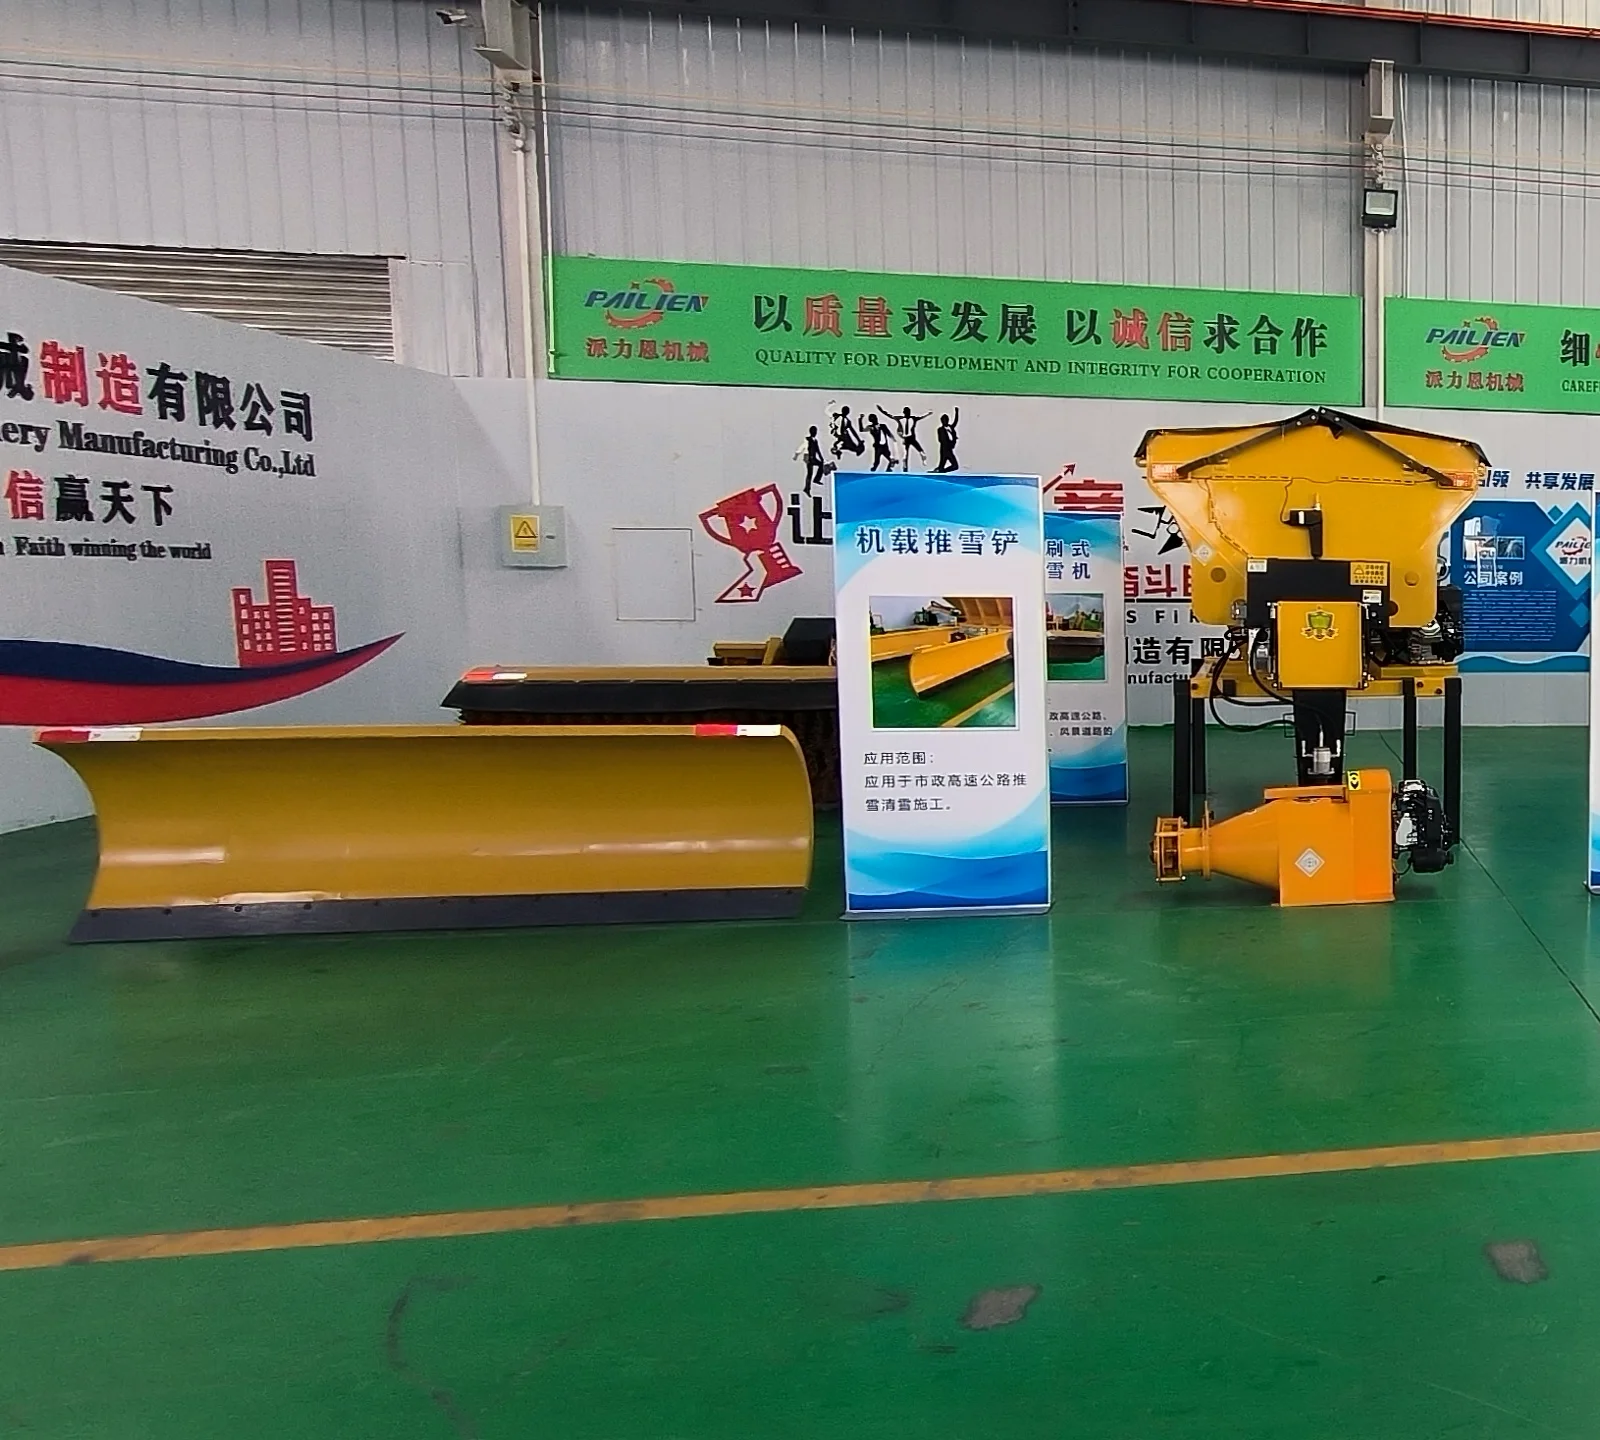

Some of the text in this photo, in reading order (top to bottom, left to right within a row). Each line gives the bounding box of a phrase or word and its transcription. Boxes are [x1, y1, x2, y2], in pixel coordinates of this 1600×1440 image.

[583, 290, 709, 313] PAILIEN
[753, 293, 1329, 358] 以质量求发展 以诚信求合作
[1425, 328, 1526, 348] PAILIEN
[585, 337, 711, 363] 派力恩机械
[755, 349, 1326, 384] QUALITY FOR DEVELOPMENT AND INTEGRITY FOR COOPERATION
[1425, 371, 1525, 392] 派力恩机械
[0, 420, 317, 477] ery Manufacturing Co.,Ltd
[1525, 472, 1595, 491] 共享发展
[5, 470, 174, 526] 信赢天下
[15, 536, 66, 557] Faith
[70, 538, 138, 561] winning
[140, 541, 166, 558] the
[170, 542, 212, 560] world
[856, 527, 1020, 557] 机载推雪铲
[864, 773, 1028, 788] 应用于市政高速公路推
